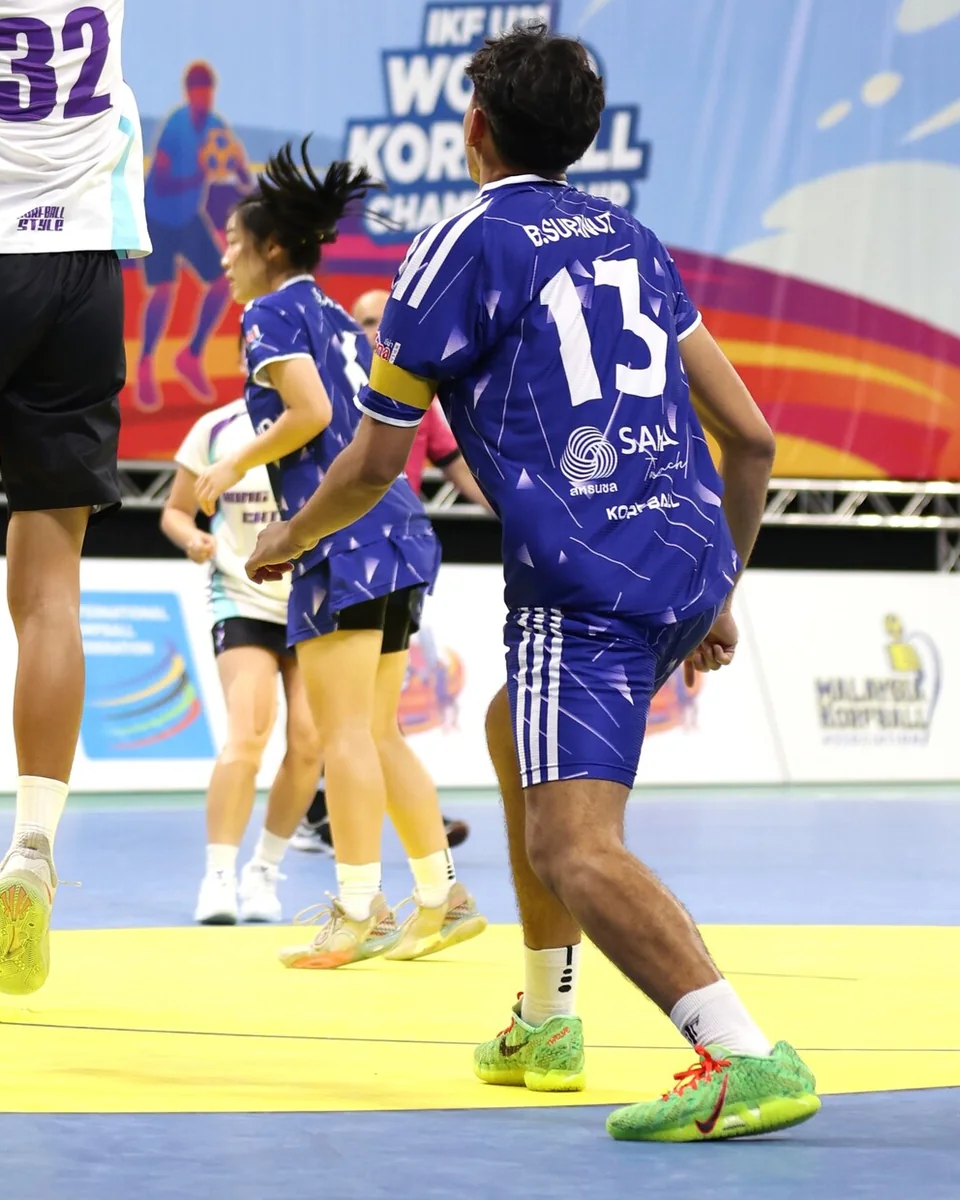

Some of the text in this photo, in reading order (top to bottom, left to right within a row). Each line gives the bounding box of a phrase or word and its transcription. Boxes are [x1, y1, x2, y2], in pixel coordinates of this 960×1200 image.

[426, 6, 487, 46] IKF
[16, 205, 65, 219] ORFBALL
[540, 258, 668, 406] 13
